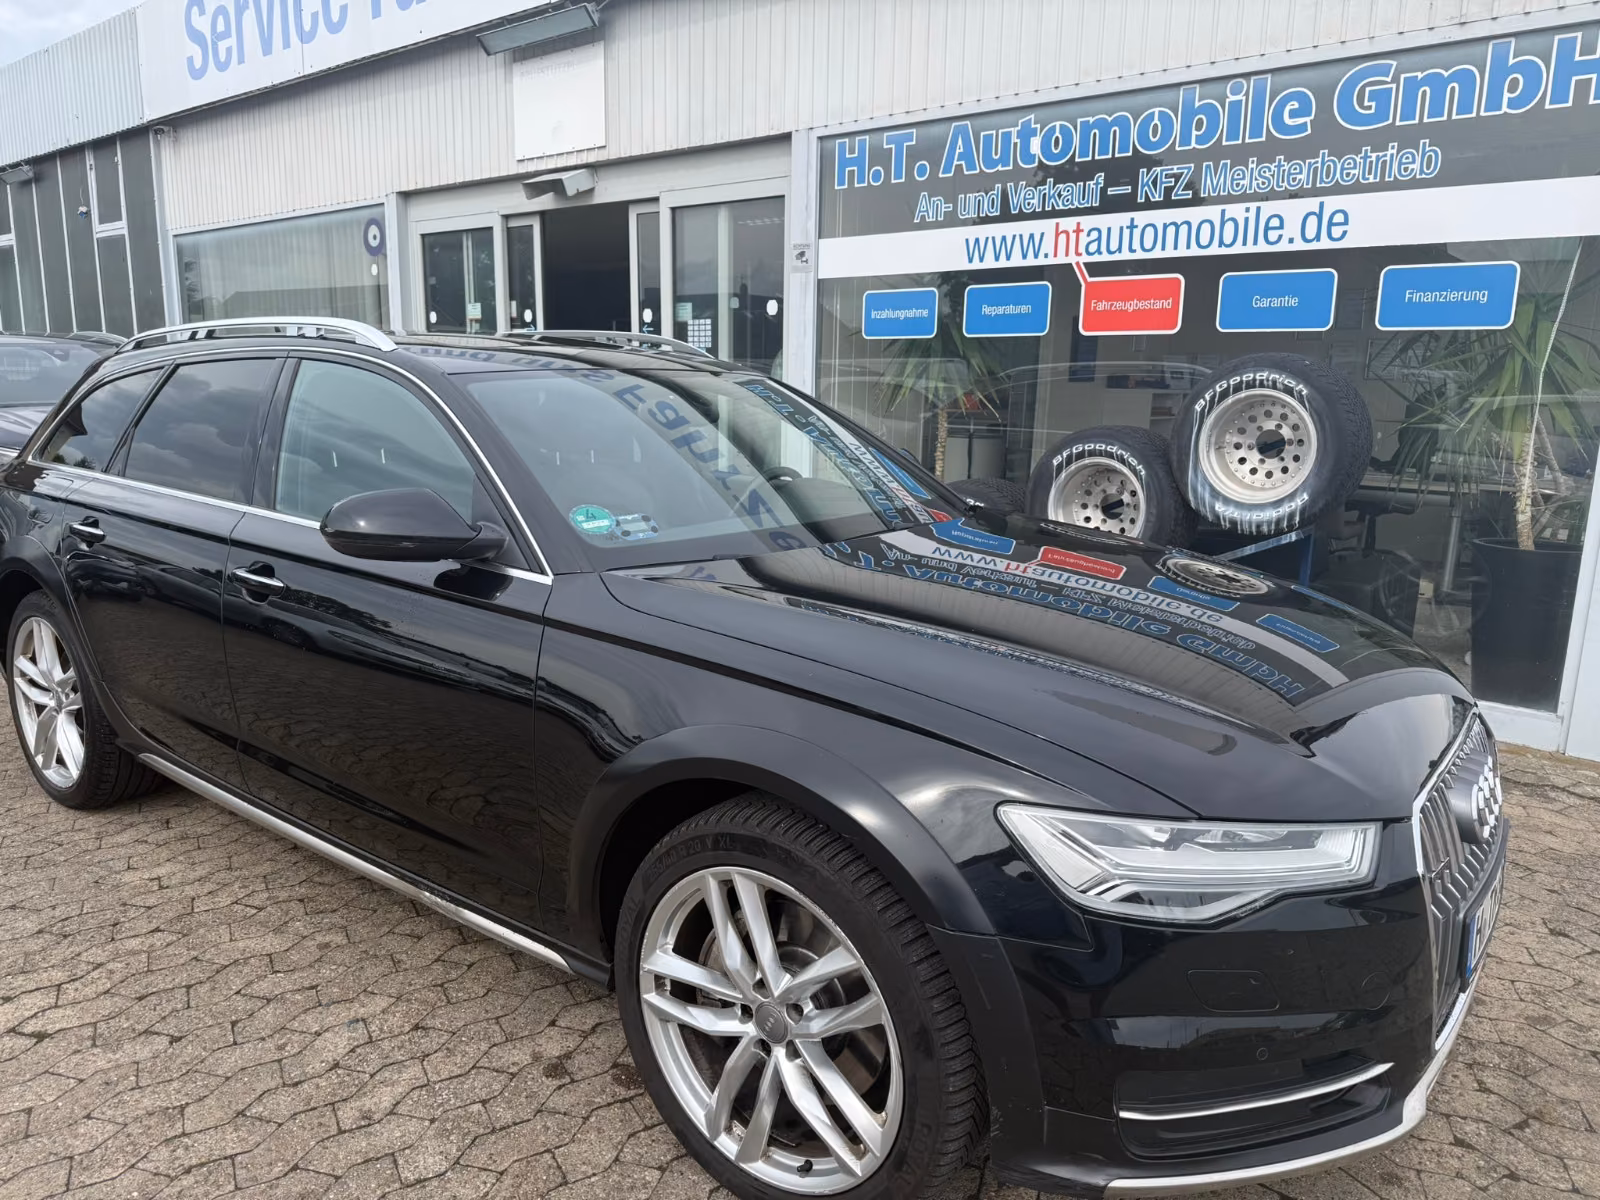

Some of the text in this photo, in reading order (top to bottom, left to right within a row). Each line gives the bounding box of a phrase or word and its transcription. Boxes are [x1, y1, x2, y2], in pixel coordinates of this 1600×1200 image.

[834, 26, 1600, 190] H.T. Automobile GmbH
[913, 191, 953, 223] An-
[957, 184, 1002, 219] und
[1007, 172, 1105, 214] Verkauf
[1137, 163, 1195, 203] KFZ
[1200, 139, 1442, 198] Meisterbetrieb
[965, 201, 1350, 264] www.htautomobile.de
[981, 303, 1032, 316] Reparaturen
[1090, 297, 1173, 313] Fahrzeugbestand
[1252, 294, 1299, 309] Garantie
[1404, 288, 1489, 305] Finanzierung
[1194, 370, 1310, 412] BFGoodrich
[1052, 442, 1147, 477] BFGoodrich
